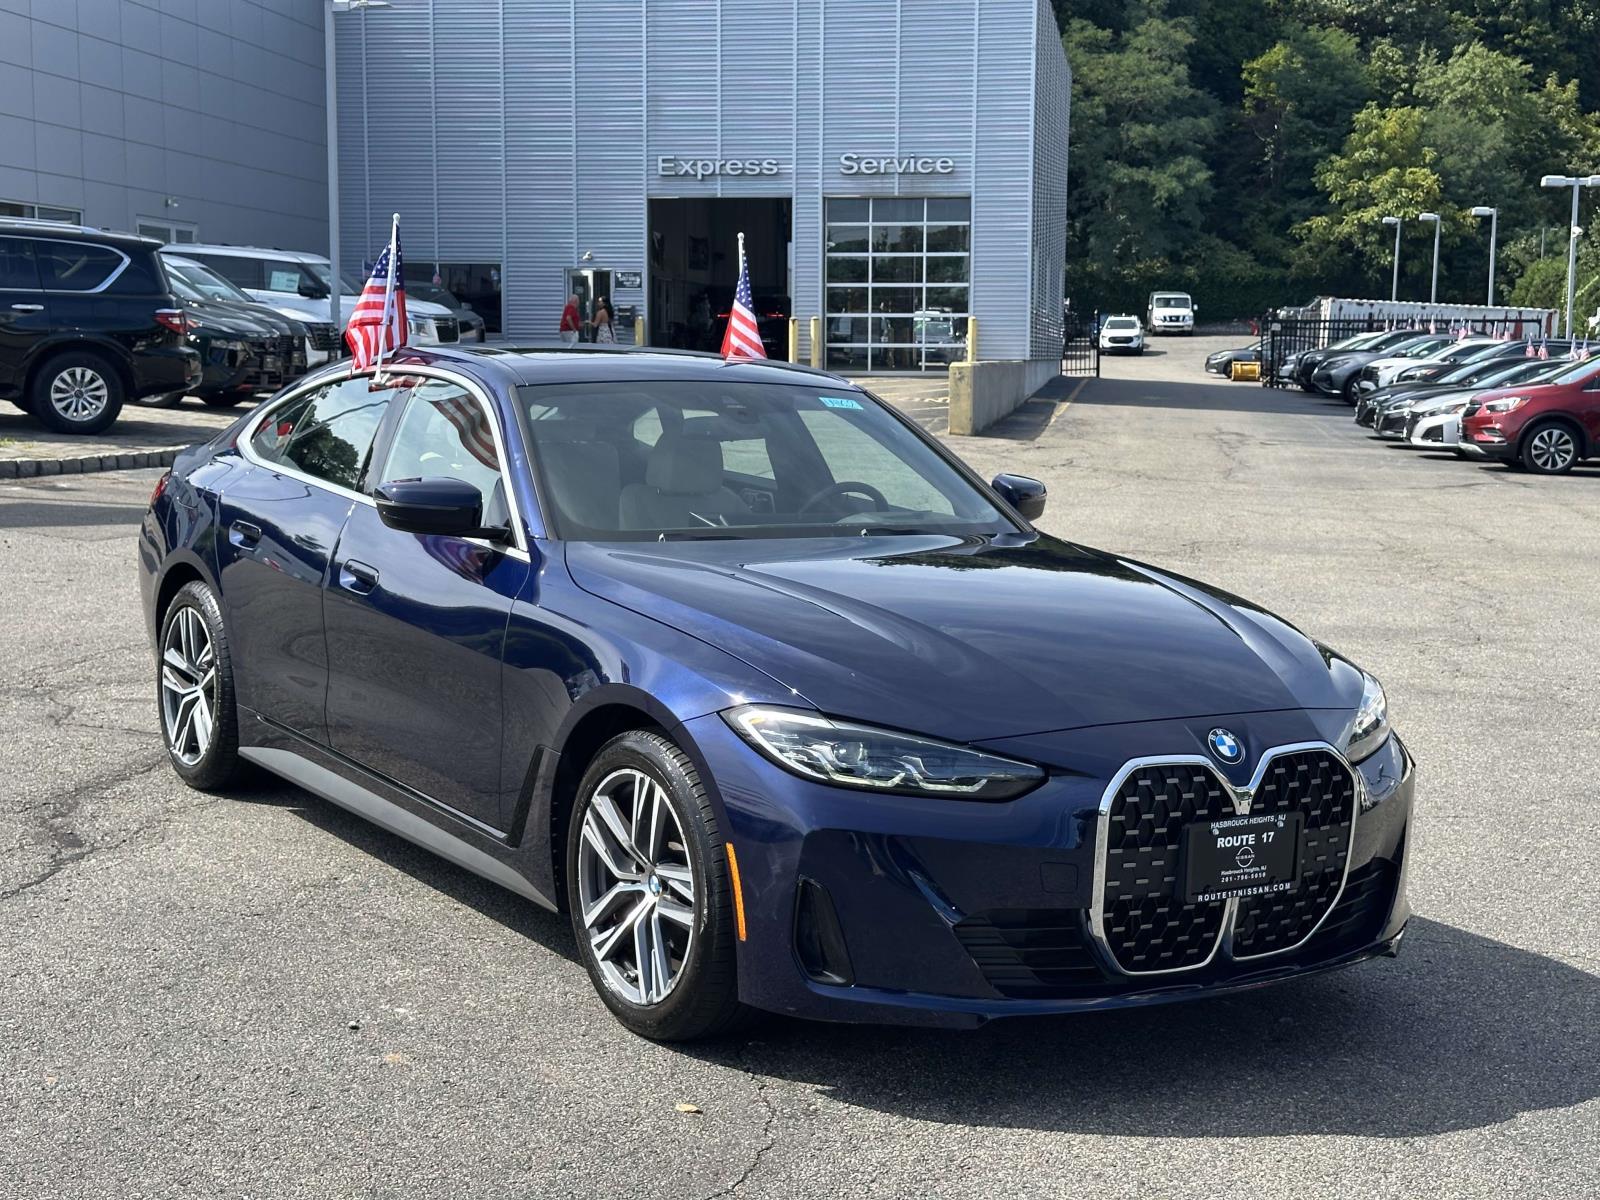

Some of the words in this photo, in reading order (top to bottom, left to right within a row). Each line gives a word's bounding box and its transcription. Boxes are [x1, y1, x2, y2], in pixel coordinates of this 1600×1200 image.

[657, 155, 779, 180] Express
[840, 153, 955, 174] Service
[1210, 729, 1235, 741] BMW
[1210, 819, 1248, 829] HASBROUCK
[1278, 814, 1287, 822] NJ
[1216, 834, 1256, 848] ROUTE
[1261, 831, 1275, 843] 17
[1197, 882, 1291, 902] ROUTE17NISSAN.COM
